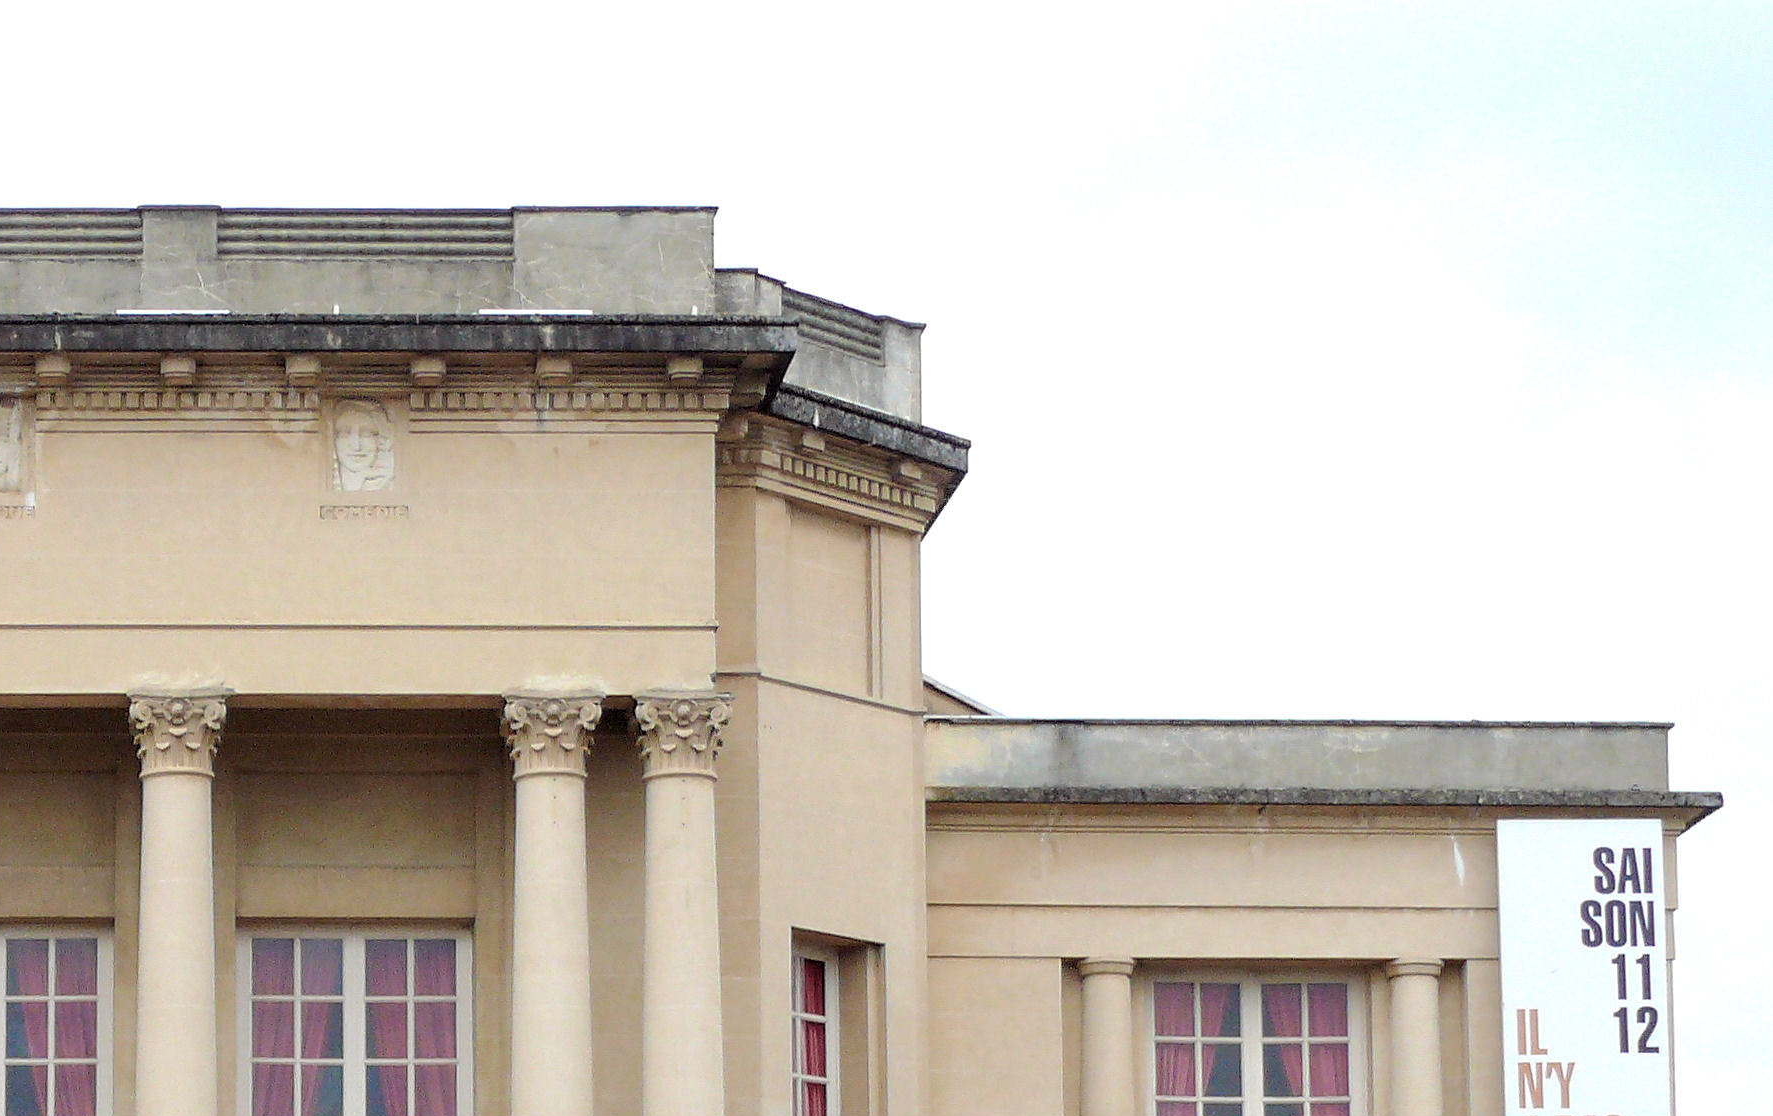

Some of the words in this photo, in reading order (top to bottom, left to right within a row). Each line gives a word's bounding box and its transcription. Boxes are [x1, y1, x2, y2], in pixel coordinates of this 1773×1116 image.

[1593, 847, 1653, 894] SAI
[1580, 900, 1655, 948] SON
[1612, 953, 1651, 1000] 11
[1517, 1009, 1548, 1055] IL
[1613, 1006, 1659, 1054] 12
[1518, 1062, 1575, 1108] N'Y
